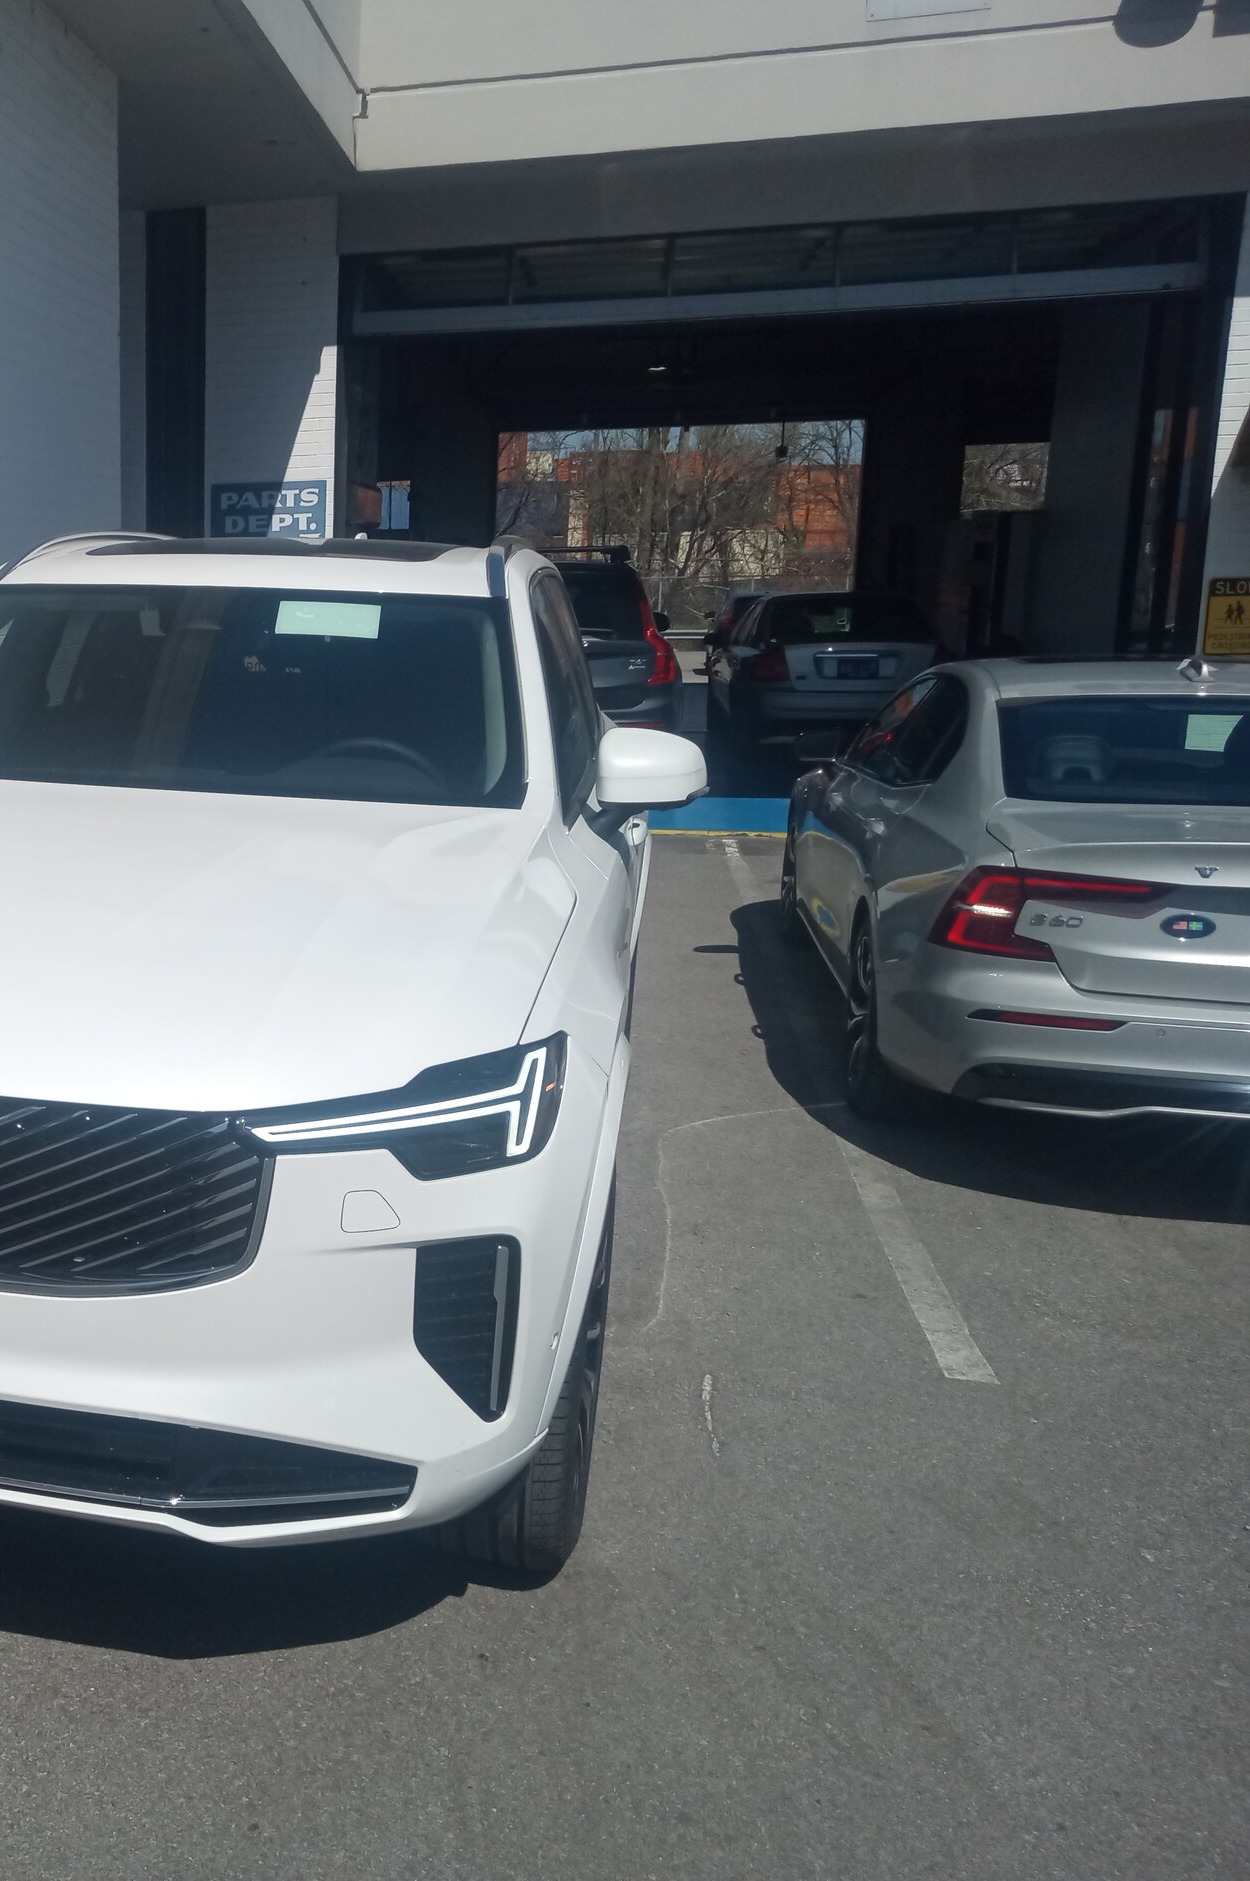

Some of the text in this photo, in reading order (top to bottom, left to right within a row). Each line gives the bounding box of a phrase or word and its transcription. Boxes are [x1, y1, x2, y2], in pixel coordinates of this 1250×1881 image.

[220, 487, 320, 510] PARTS
[224, 512, 317, 534] DEPT.
[1215, 581, 1250, 594] SLO
